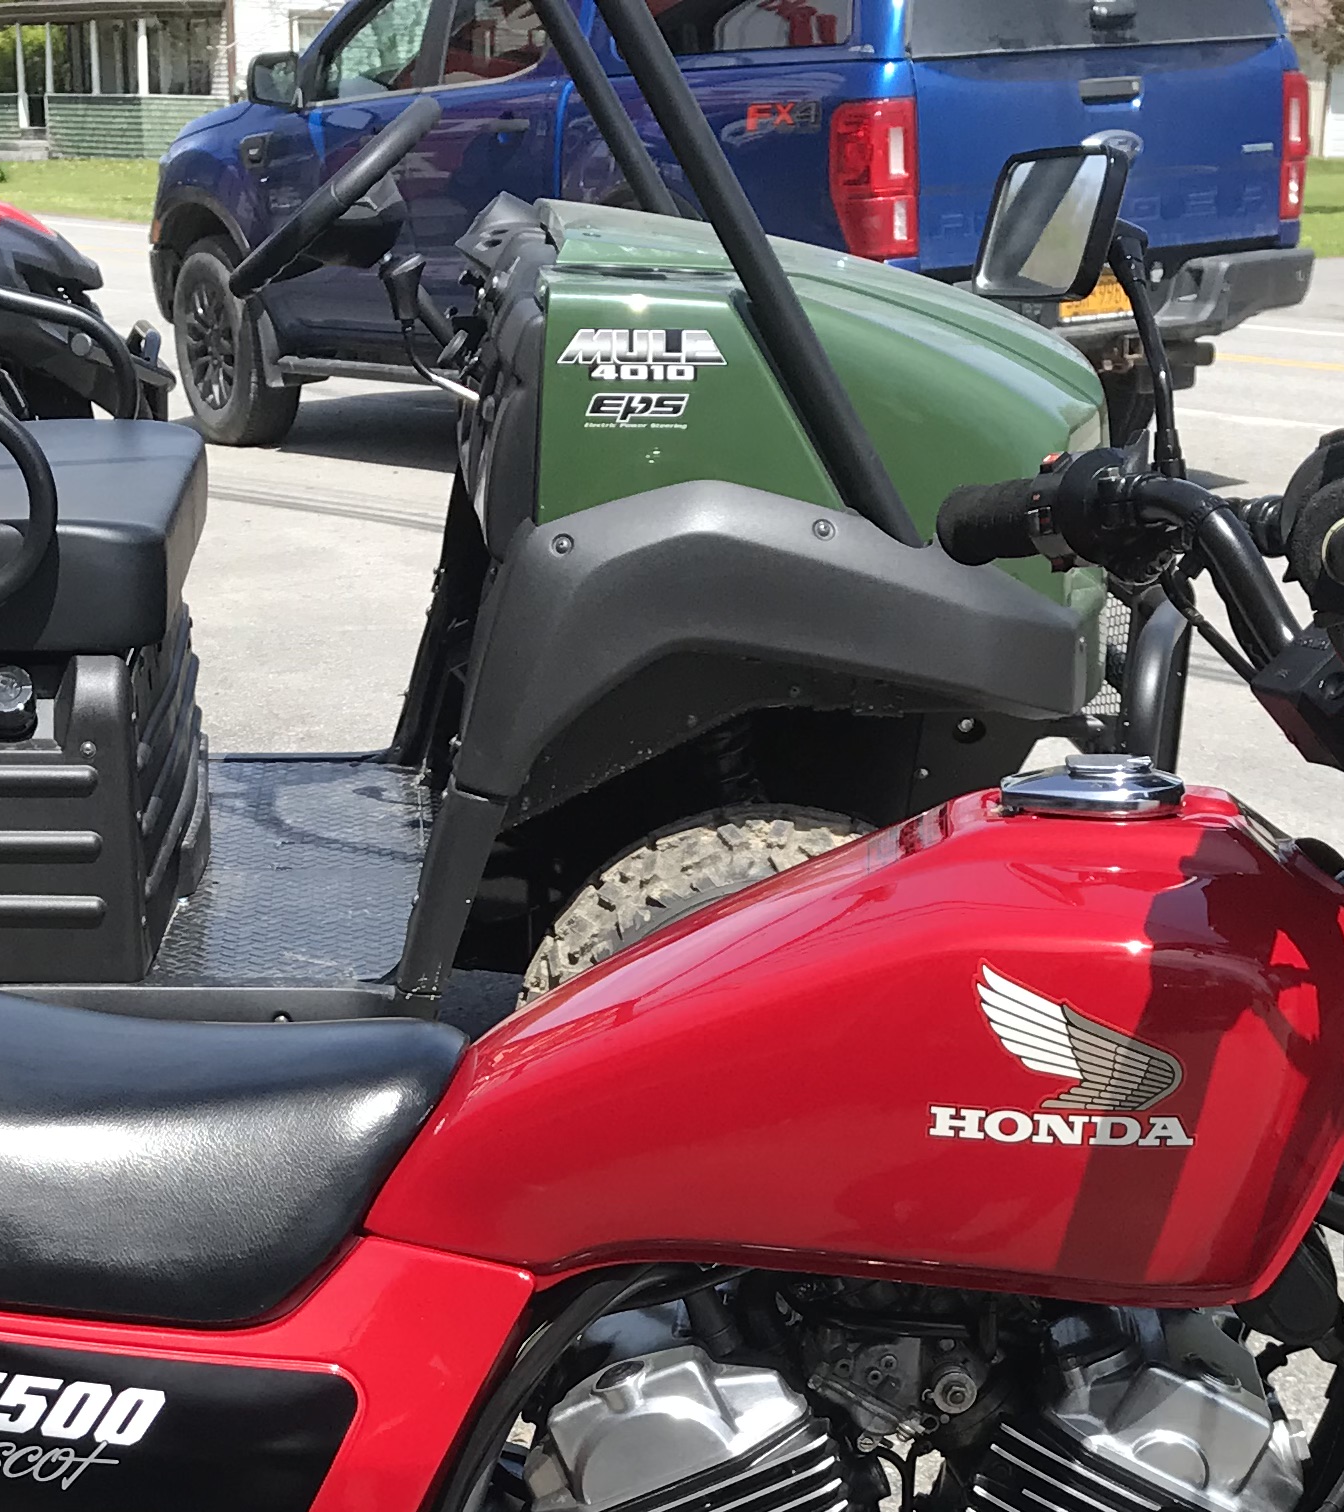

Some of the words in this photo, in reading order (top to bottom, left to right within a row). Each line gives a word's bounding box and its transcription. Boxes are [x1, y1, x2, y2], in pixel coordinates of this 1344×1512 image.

[746, 101, 817, 132] FX4
[557, 328, 727, 365] MULE
[591, 364, 694, 380] 4010
[650, 422, 688, 430] Steering
[927, 1105, 1195, 1147] HONDA
